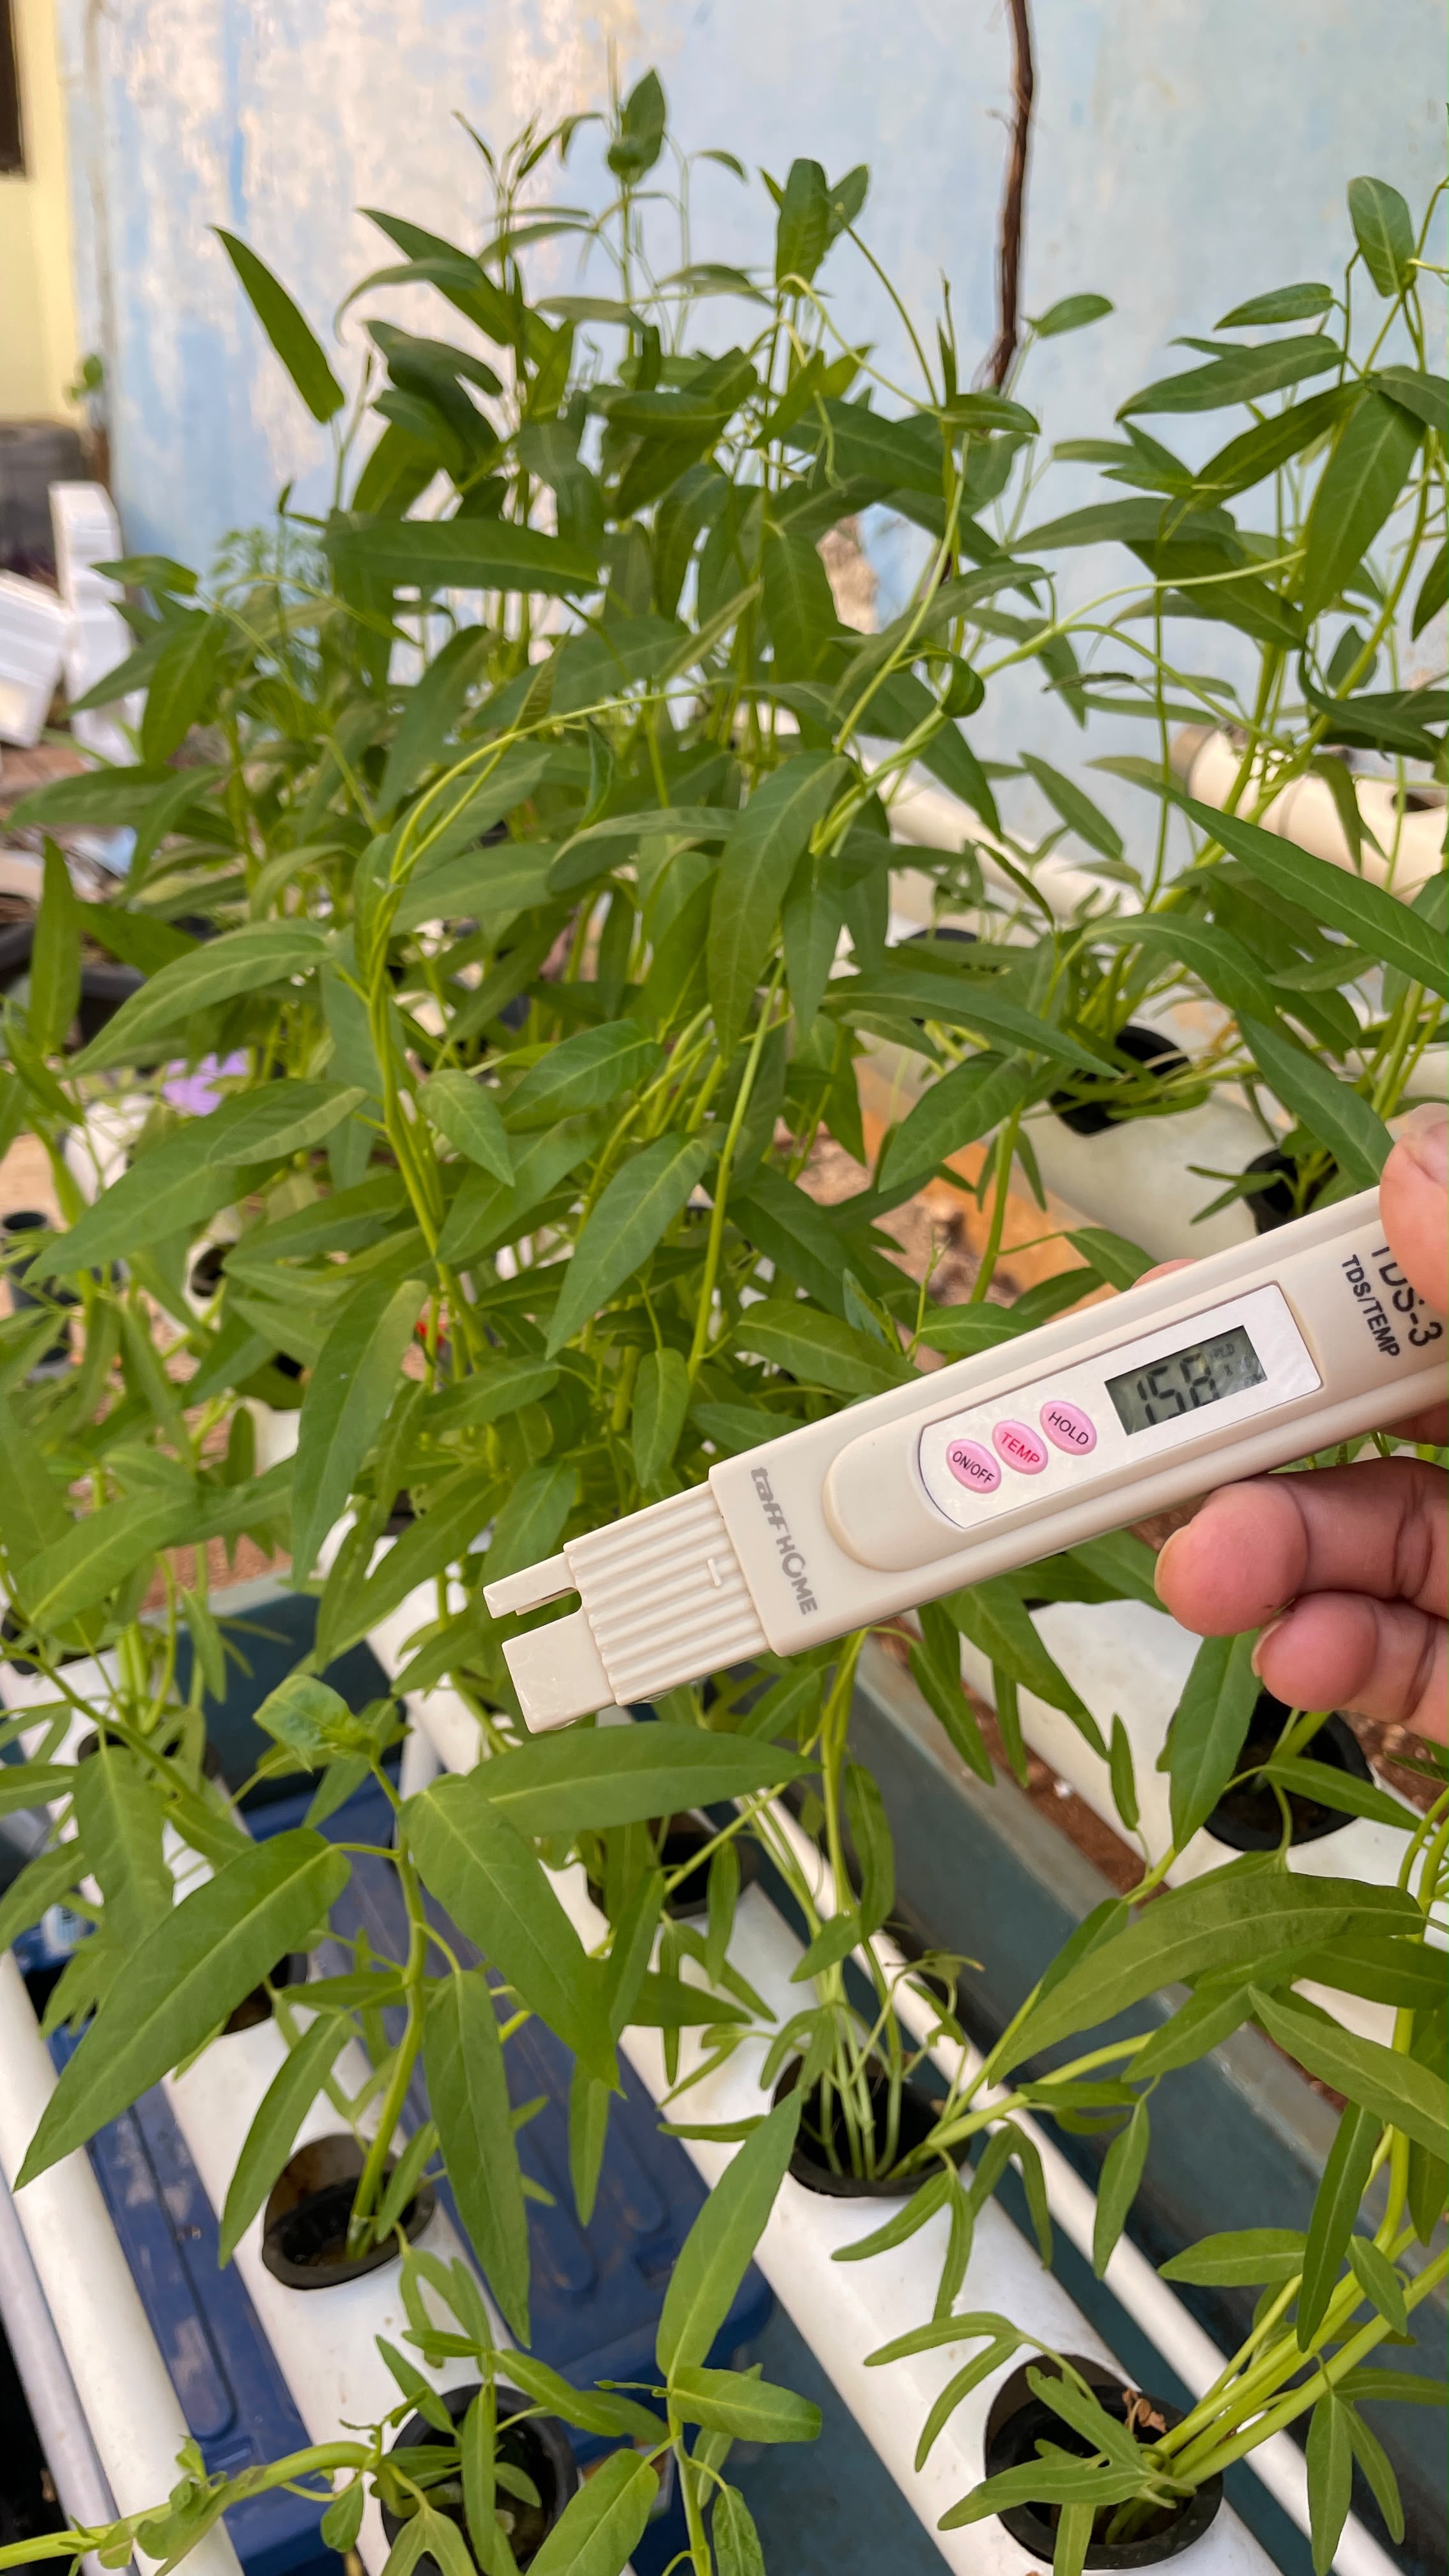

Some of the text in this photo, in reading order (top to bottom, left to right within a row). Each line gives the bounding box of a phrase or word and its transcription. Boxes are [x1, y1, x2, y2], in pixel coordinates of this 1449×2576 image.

[1342, 1254, 1400, 1356] TDS/TEMP
[1048, 1411, 1089, 1445] HOLD
[1001, 1432, 1040, 1464] TEMP
[952, 1451, 995, 1484] ON/OFF
